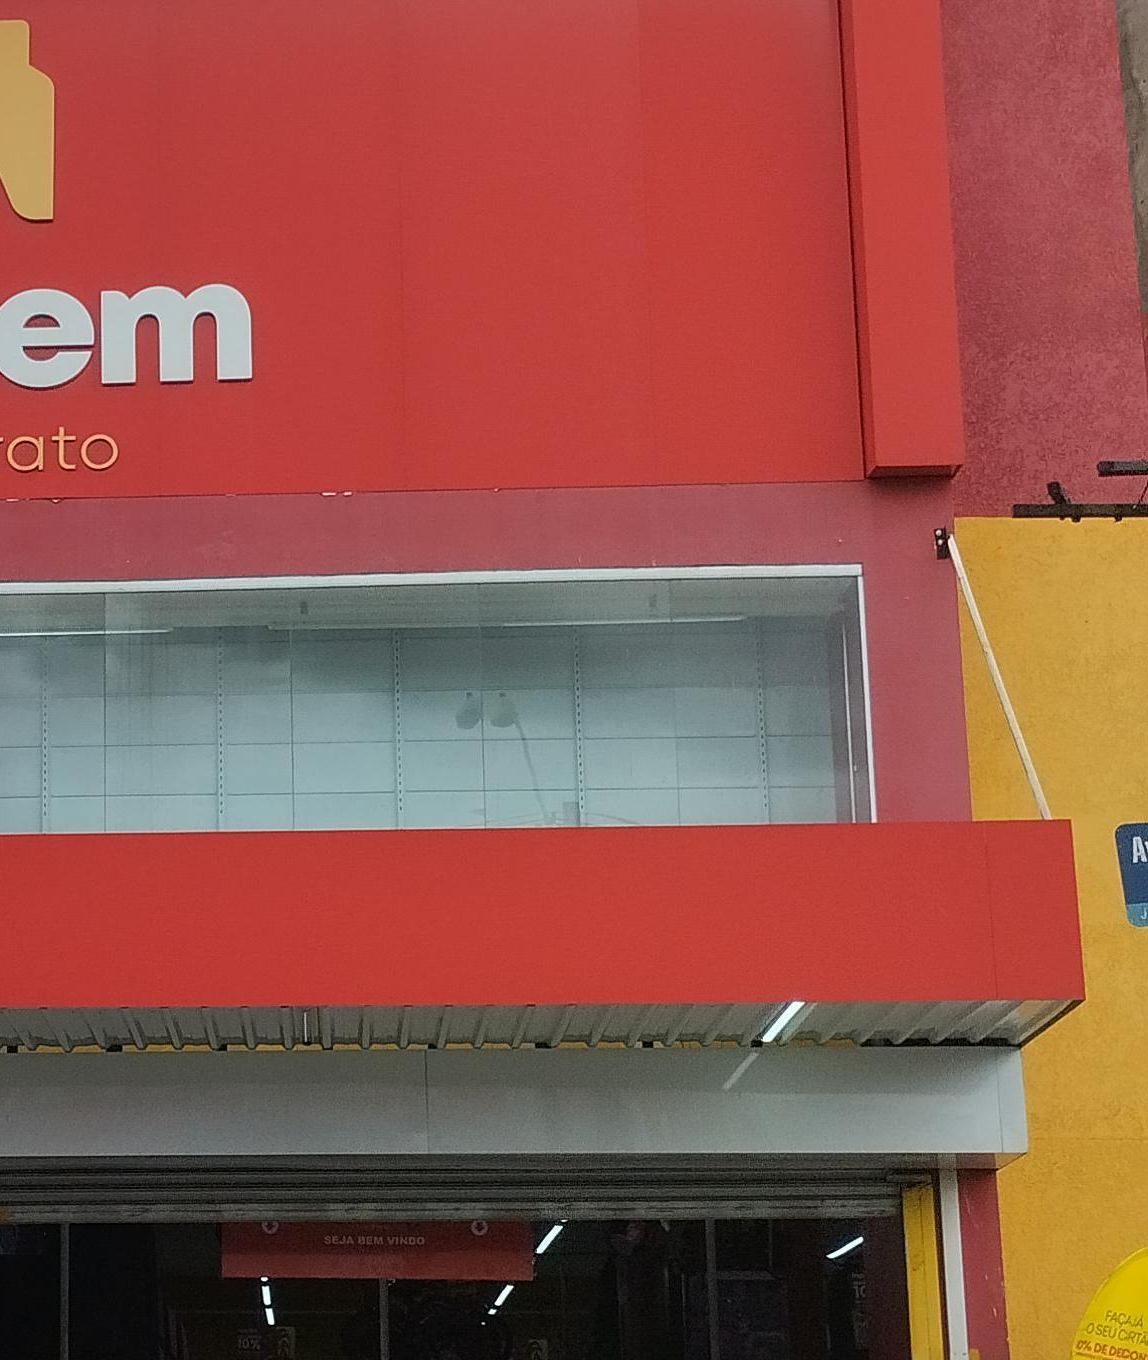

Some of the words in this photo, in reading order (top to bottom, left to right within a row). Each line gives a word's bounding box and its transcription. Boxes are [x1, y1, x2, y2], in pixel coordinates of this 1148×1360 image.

[324, 1235, 354, 1246] SEJA
[357, 1235, 384, 1246] BEM
[388, 1235, 425, 1246] VINDO
[1095, 1323, 1118, 1339] SEU
[1093, 1342, 1109, 1356] DE
